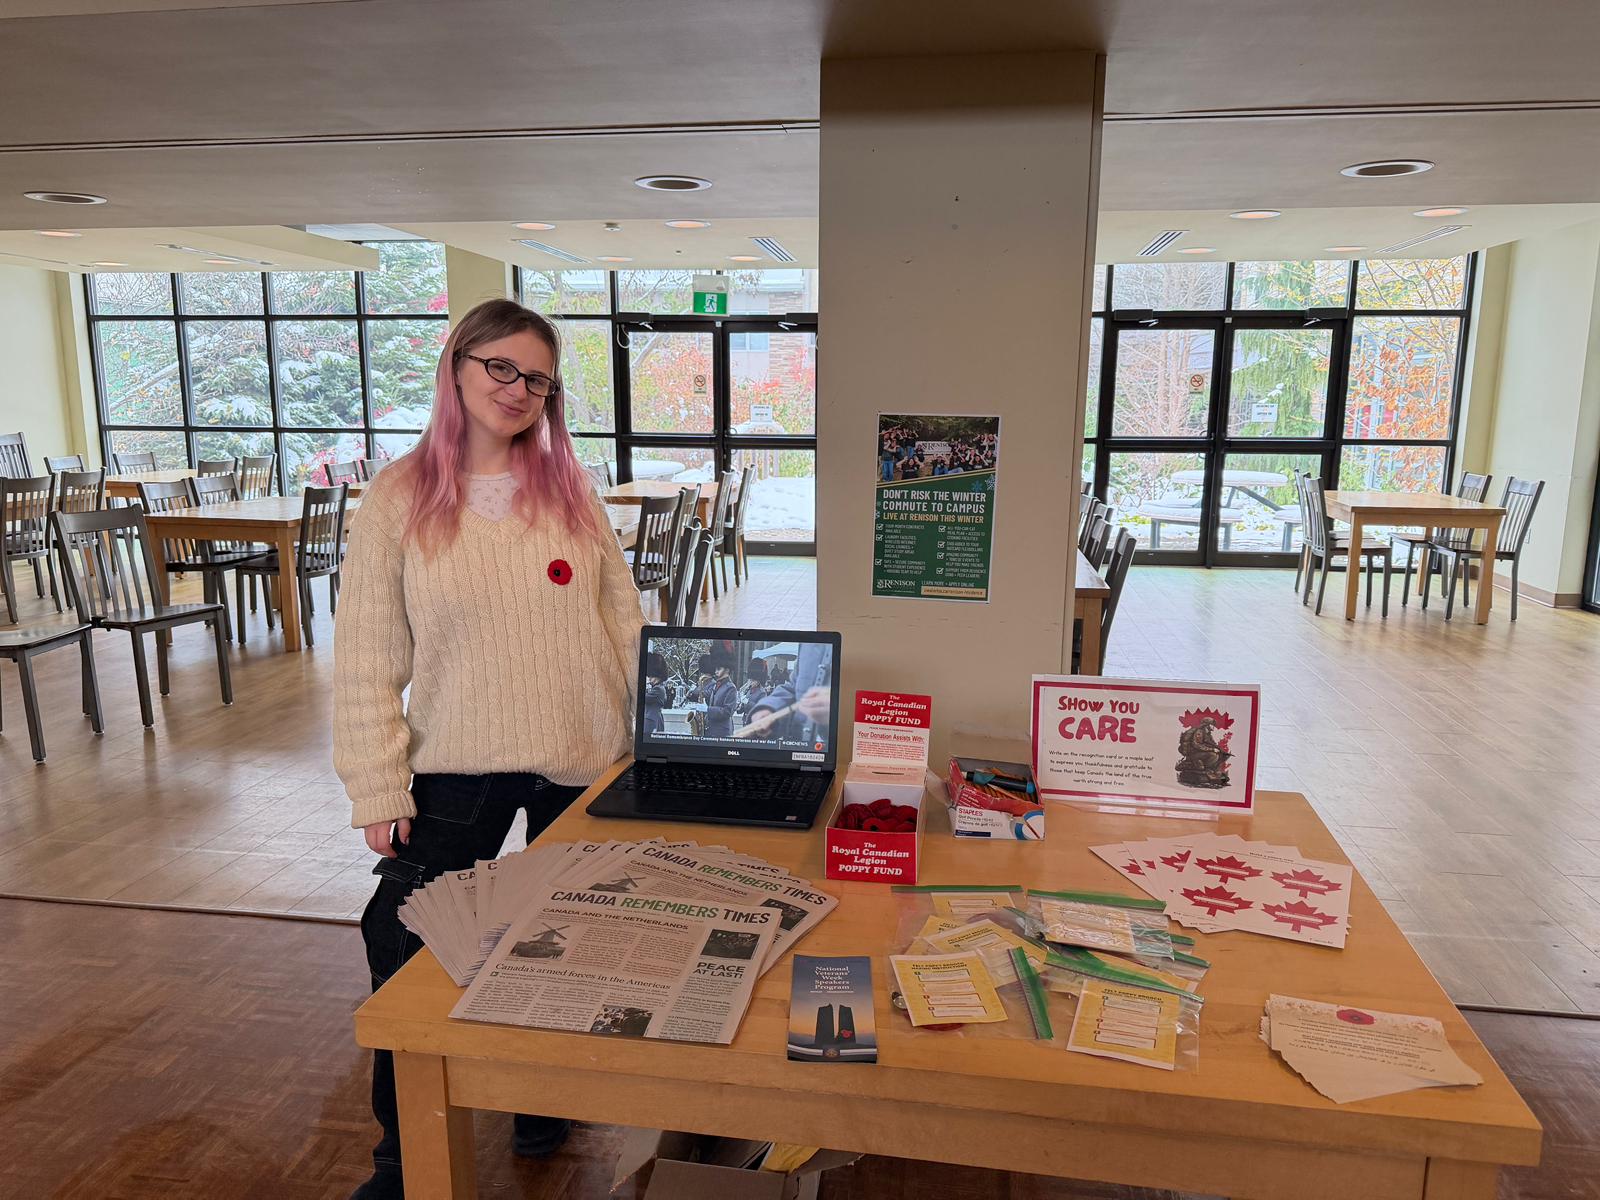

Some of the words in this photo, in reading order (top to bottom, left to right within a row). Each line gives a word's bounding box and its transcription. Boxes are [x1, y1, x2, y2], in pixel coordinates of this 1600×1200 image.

[884, 490, 910, 500] DON'T
[911, 491, 930, 500] RISK
[933, 492, 950, 501] THE
[952, 492, 986, 502] WINTER
[883, 501, 927, 511] COMMUTE
[932, 502, 942, 512] TO
[946, 503, 985, 514] CAMPUS
[910, 514, 938, 522] RENISON
[958, 515, 984, 523] WINTER
[884, 580, 915, 588] RENISON
[861, 698, 885, 707] Royal
[888, 701, 927, 710] Canadian
[1058, 696, 1104, 712] SHOW
[1109, 700, 1140, 714] YOU
[880, 708, 909, 716] Legion
[864, 714, 893, 723] POPPY
[895, 717, 920, 725] FUND
[1058, 715, 1137, 743] CARE
[959, 808, 983, 816] STAPLES
[832, 846, 860, 856] Royal
[863, 848, 909, 858] Canadian
[854, 856, 886, 865] Legion
[838, 863, 870, 873] POPPY
[873, 866, 902, 876] FUND
[630, 860, 660, 870] CANADA
[695, 878, 748, 896] NETHERLANDS
[642, 847, 698, 868] CANADA
[698, 865, 783, 892] REMEMBERS
[783, 886, 827, 905] TIMES
[551, 891, 616, 906] CANADA
[620, 898, 719, 918] REMEMBERS
[723, 909, 770, 924] TIMES
[623, 916, 688, 930] NETHERLANDS
[697, 962, 746, 973] PEACE
[496, 963, 535, 972] Canada's
[537, 968, 567, 976] armed
[568, 970, 596, 979] forces
[609, 975, 624, 983] the
[625, 978, 671, 989] Americas
